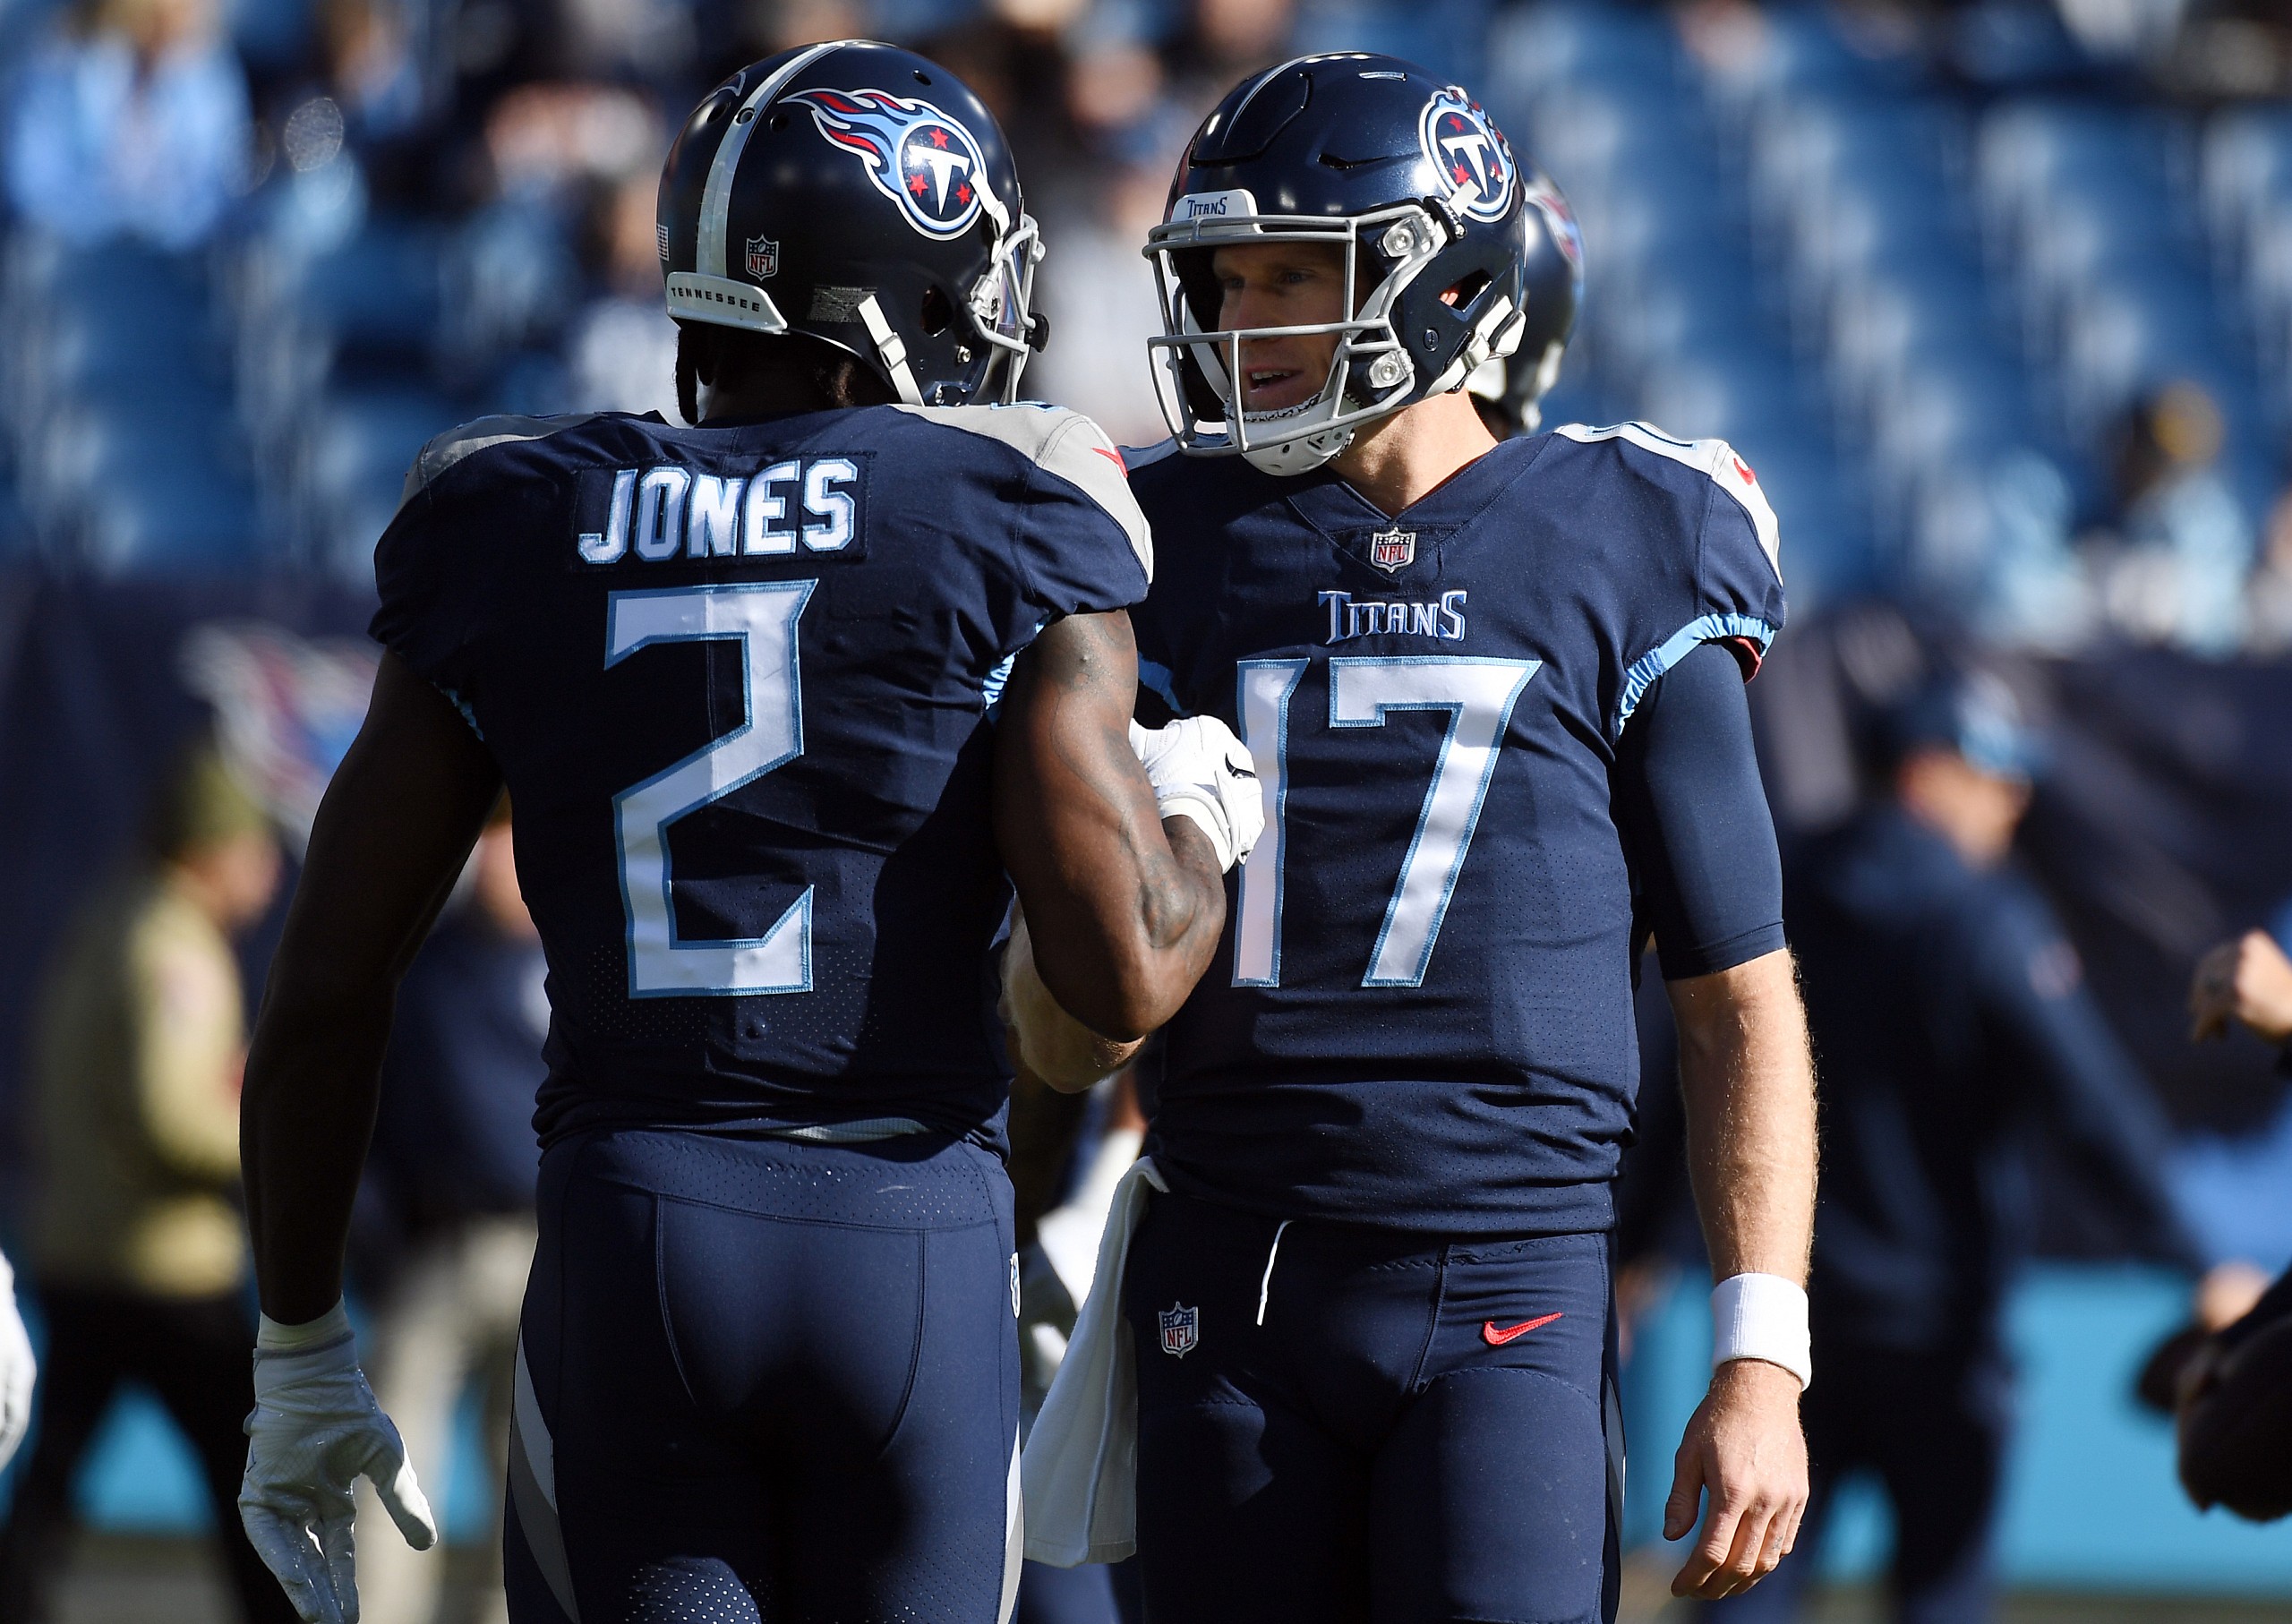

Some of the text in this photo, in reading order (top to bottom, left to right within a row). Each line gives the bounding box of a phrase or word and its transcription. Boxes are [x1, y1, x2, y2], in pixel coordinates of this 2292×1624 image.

[908, 144, 971, 216] T
[1440, 134, 1490, 199] T
[1187, 196, 1227, 218] TITANS
[750, 253, 774, 272] NFL
[671, 286, 760, 312] TENNESSEE
[577, 457, 859, 564] JONES
[1377, 544, 1407, 563] NFL
[1318, 590, 1468, 645] TITANS
[604, 578, 819, 1000] 2
[1231, 656, 1543, 987] 17
[1167, 1326, 1192, 1348] NFL
